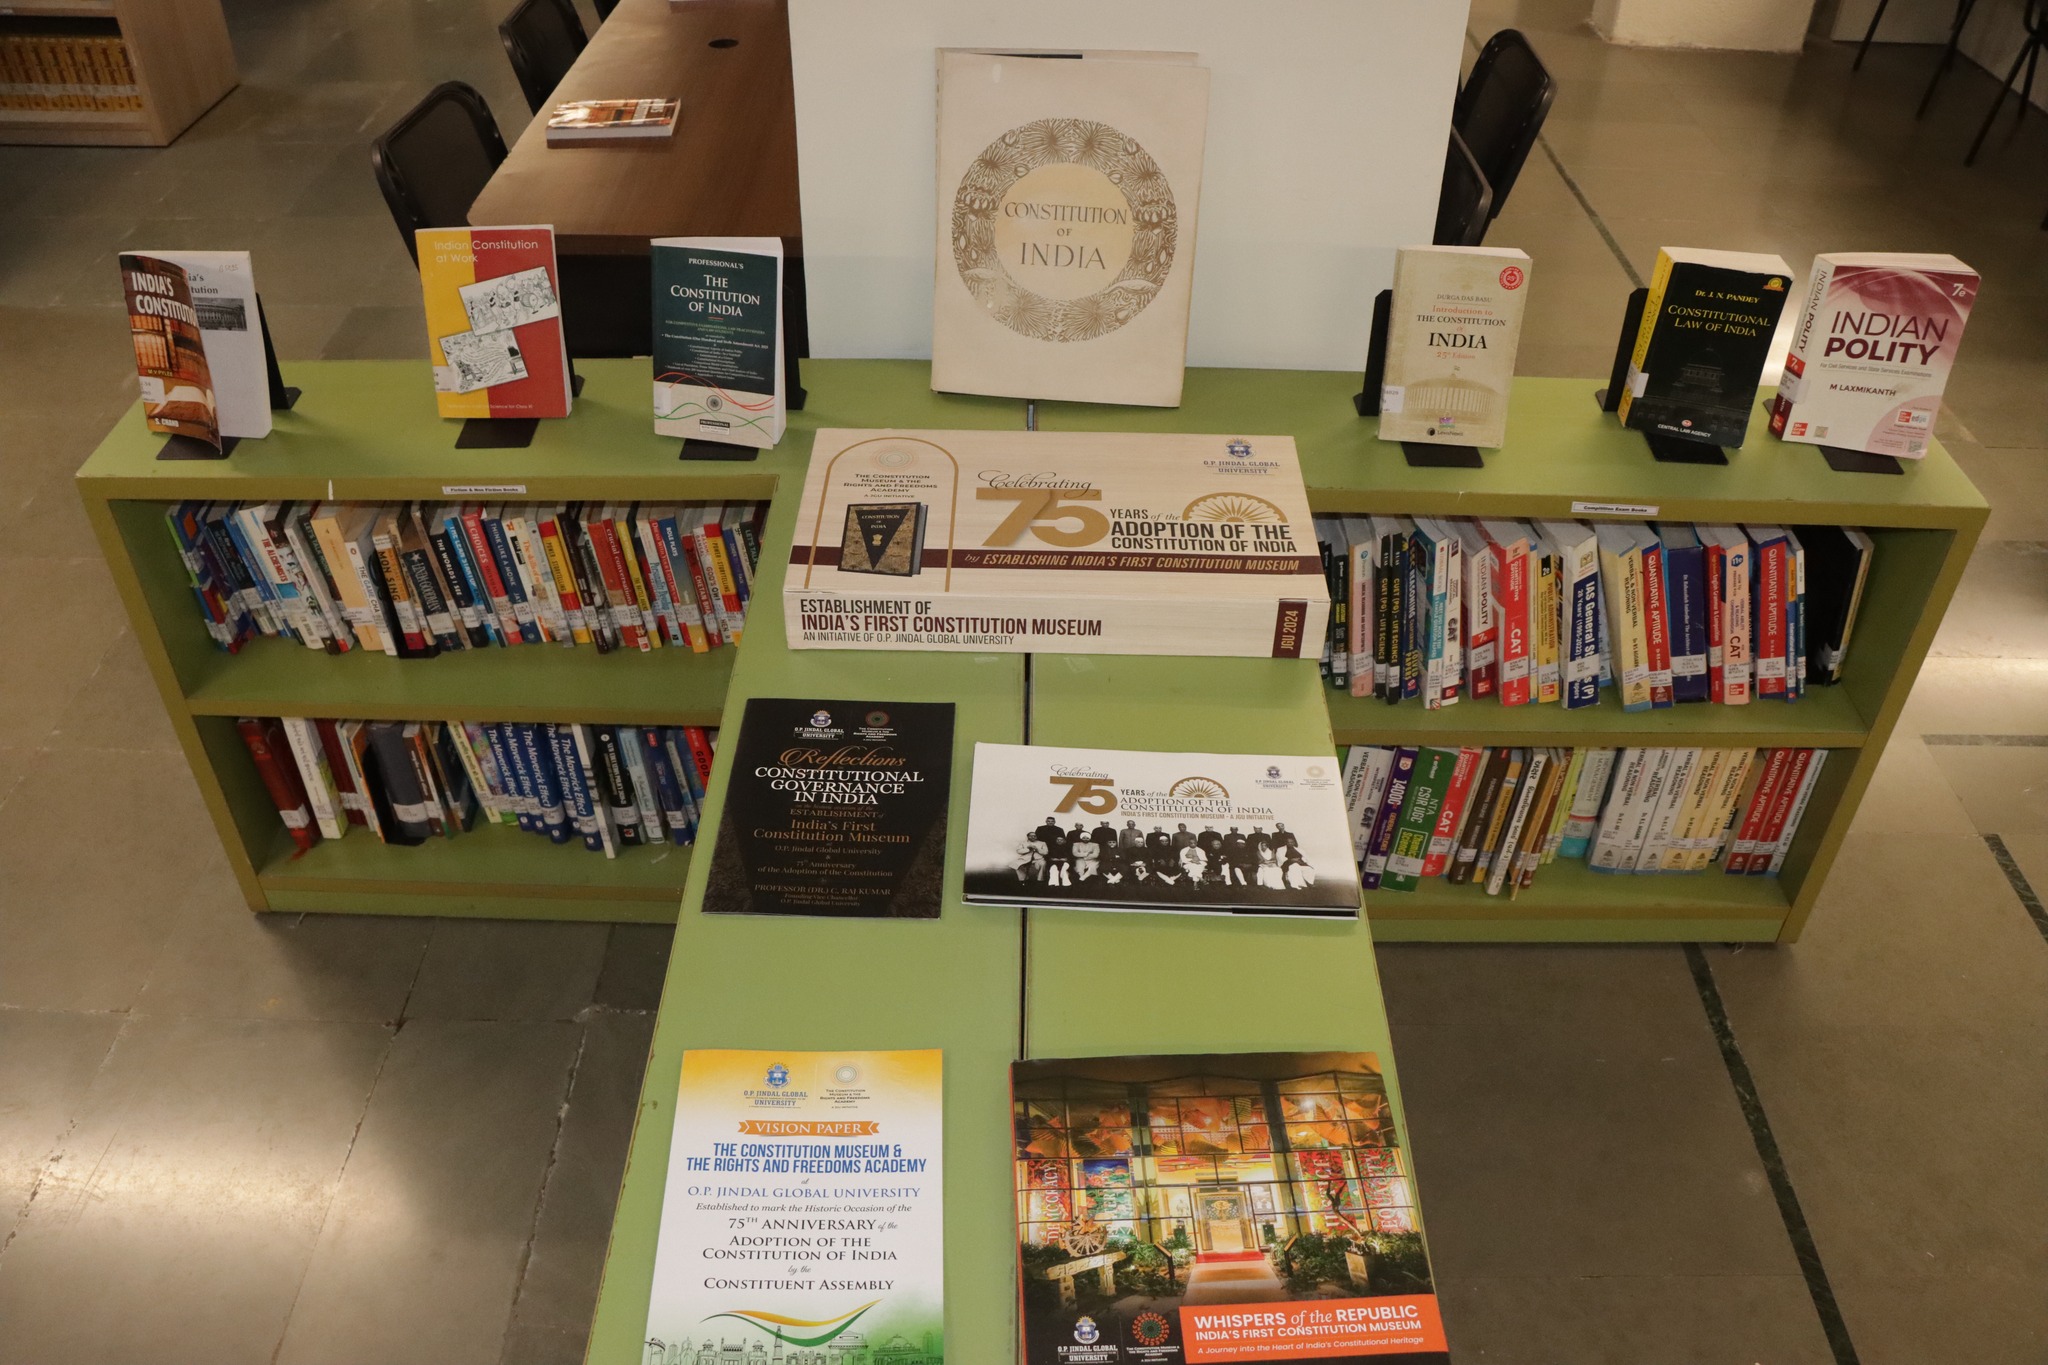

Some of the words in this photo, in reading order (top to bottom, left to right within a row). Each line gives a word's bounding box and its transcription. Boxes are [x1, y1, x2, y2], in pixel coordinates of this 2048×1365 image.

[1005, 201, 1127, 225] CONSTITUTION
[1056, 228, 1072, 237] OF
[434, 240, 469, 250] Indian
[472, 240, 538, 250] Constitution
[436, 254, 447, 262] at
[451, 254, 478, 262] Work
[688, 258, 744, 269] PROFESSIONAL'S
[1020, 242, 1106, 270] INDIA
[131, 271, 175, 297] INDIA'S
[703, 274, 728, 288] THE
[670, 285, 760, 305] CONSTITUTION
[1726, 293, 1760, 303] PANDEY
[1811, 270, 1828, 311] INDIAN
[1952, 283, 1966, 297] 7e
[689, 302, 704, 312] OF
[708, 302, 743, 317] INDIA
[1432, 305, 1485, 315] Introduction
[1668, 304, 1771, 326] CONSTITUTIONAL
[1437, 315, 1507, 327] CONSTITUTION
[1674, 318, 1703, 329] LAW
[1705, 322, 1723, 332] OF
[1724, 324, 1757, 337] INDIA
[1831, 311, 1949, 342] INDIAN
[1799, 312, 1815, 353] POLITY
[1428, 332, 1488, 350] INDIA
[1824, 337, 1941, 365] POLITY
[1829, 383, 1838, 391] M
[1839, 384, 1897, 396] LAXMIKANTH
[1657, 423, 1680, 432] CENTRAL
[1691, 430, 1711, 438] AGENCY
[978, 470, 1100, 498] Celebrating
[976, 488, 1111, 548] 75
[1110, 508, 1148, 520] YEARS
[1150, 513, 1162, 524] of
[1165, 512, 1181, 521] the
[1111, 521, 1212, 538] ADOPTION
[1220, 524, 1247, 539] OF
[1255, 525, 1292, 540] THE
[470, 528, 489, 565] CHOICES
[665, 527, 673, 541] ROLE
[669, 540, 678, 557] PLAYS
[1111, 537, 1225, 552] CONSTITUTION
[1230, 541, 1250, 552] OF
[1253, 541, 1298, 553] INDIA
[491, 523, 502, 544] THINK
[497, 545, 508, 560] LIKE
[505, 566, 516, 588] MONK
[965, 554, 981, 563] by
[982, 554, 1069, 566] ESTABLISHING
[1071, 555, 1117, 567] INDIA'S
[1119, 557, 1155, 568] FIRST
[1156, 558, 1243, 571] CONSTITUTION
[1245, 561, 1300, 572] MUSEUM
[442, 553, 456, 580] WORLDS
[1479, 556, 1488, 591] INDIAN
[1648, 555, 1660, 609] QUANTITATIVE
[1585, 581, 1595, 601] IAS
[800, 599, 911, 615] ESTABLISHMENT
[914, 601, 933, 614] OF
[1480, 592, 1488, 625] POLITY
[801, 614, 861, 632] INDIA'S
[864, 616, 910, 632] FIRST
[913, 616, 1027, 635] CONSTITUTION
[1031, 619, 1103, 636] MUSEUM
[1282, 610, 1299, 635] 2024
[1584, 602, 1595, 643] General
[1652, 611, 1662, 645] APTITUDE
[803, 632, 815, 640] AN
[817, 632, 861, 642] INITIATIVE
[863, 633, 874, 642] OF
[876, 634, 892, 643] O.P.
[895, 634, 924, 643] JINDAL
[927, 635, 960, 645] GLOBAL
[963, 635, 1015, 646] UNIVERSITY
[1280, 636, 1294, 651] JGU
[1511, 629, 1521, 655] CAT
[777, 746, 907, 771] Reflections
[523, 730, 533, 746] The
[528, 747, 546, 784] Maverick
[538, 784, 552, 807] Effect
[755, 767, 924, 782] CONSTITUTIONAL
[1050, 764, 1108, 780] Celebrating
[771, 779, 905, 795] GOVERNANCE
[1120, 789, 1145, 797] YEARS
[1147, 791, 1155, 799] of
[794, 792, 817, 803] IN
[821, 793, 879, 804] INDIA
[1050, 776, 1119, 815] 75
[1120, 797, 1187, 806] ADOPTION
[1206, 799, 1231, 807] THE
[790, 809, 878, 819] ESTABLISHMENT
[1120, 803, 1220, 813] CONSTITUTION
[1237, 806, 1273, 815] INDIA
[792, 820, 838, 831] India's
[843, 822, 876, 832] First
[754, 828, 843, 841] Constitution
[850, 833, 910, 844] Museum
[756, 1123, 811, 1134] VISION
[816, 1123, 863, 1134] PAPER
[713, 1143, 737, 1157] THE
[741, 1143, 831, 1158] CONSTITUTION
[834, 1144, 889, 1158] MUSEUM
[893, 1144, 902, 1157] &
[687, 1157, 711, 1171] THE
[714, 1158, 760, 1172] RIGHTS
[763, 1159, 790, 1173] AND
[793, 1159, 861, 1173] FREEDOMS
[864, 1158, 927, 1173] ACADEMY
[688, 1186, 712, 1196] O.P.
[716, 1187, 769, 1198] JINDAL
[773, 1187, 829, 1198] GLOBAL
[834, 1187, 921, 1198] UNIVERSITY
[728, 1217, 758, 1230] 75TH
[762, 1219, 877, 1231] ANNIVERSARY
[729, 1235, 811, 1247] ADOPTION
[816, 1237, 836, 1247] OF
[841, 1237, 871, 1247] THE
[702, 1248, 820, 1260] CONSTITUTION
[826, 1250, 846, 1260] OF
[852, 1249, 897, 1260] INDIA
[704, 1277, 815, 1290] CONSTITUENT
[819, 1279, 895, 1290] ASSEMBLY
[1194, 1312, 1287, 1329] WHISPERS
[1290, 1310, 1307, 1328] of
[1309, 1310, 1333, 1324] the
[1335, 1305, 1418, 1322] REPUBLIC
[1195, 1330, 1241, 1341] INDIA'S
[1242, 1328, 1275, 1339] FIRST
[1277, 1323, 1367, 1337] CONSTITUTION
[1369, 1320, 1422, 1333] MUSEUM
[1205, 1346, 1238, 1354] Journey
[1272, 1342, 1294, 1351] Heart
[1295, 1342, 1304, 1350] of
[1306, 1340, 1331, 1349] India's
[1333, 1337, 1388, 1348] Constitutional
[1390, 1336, 1424, 1346] Heritage
